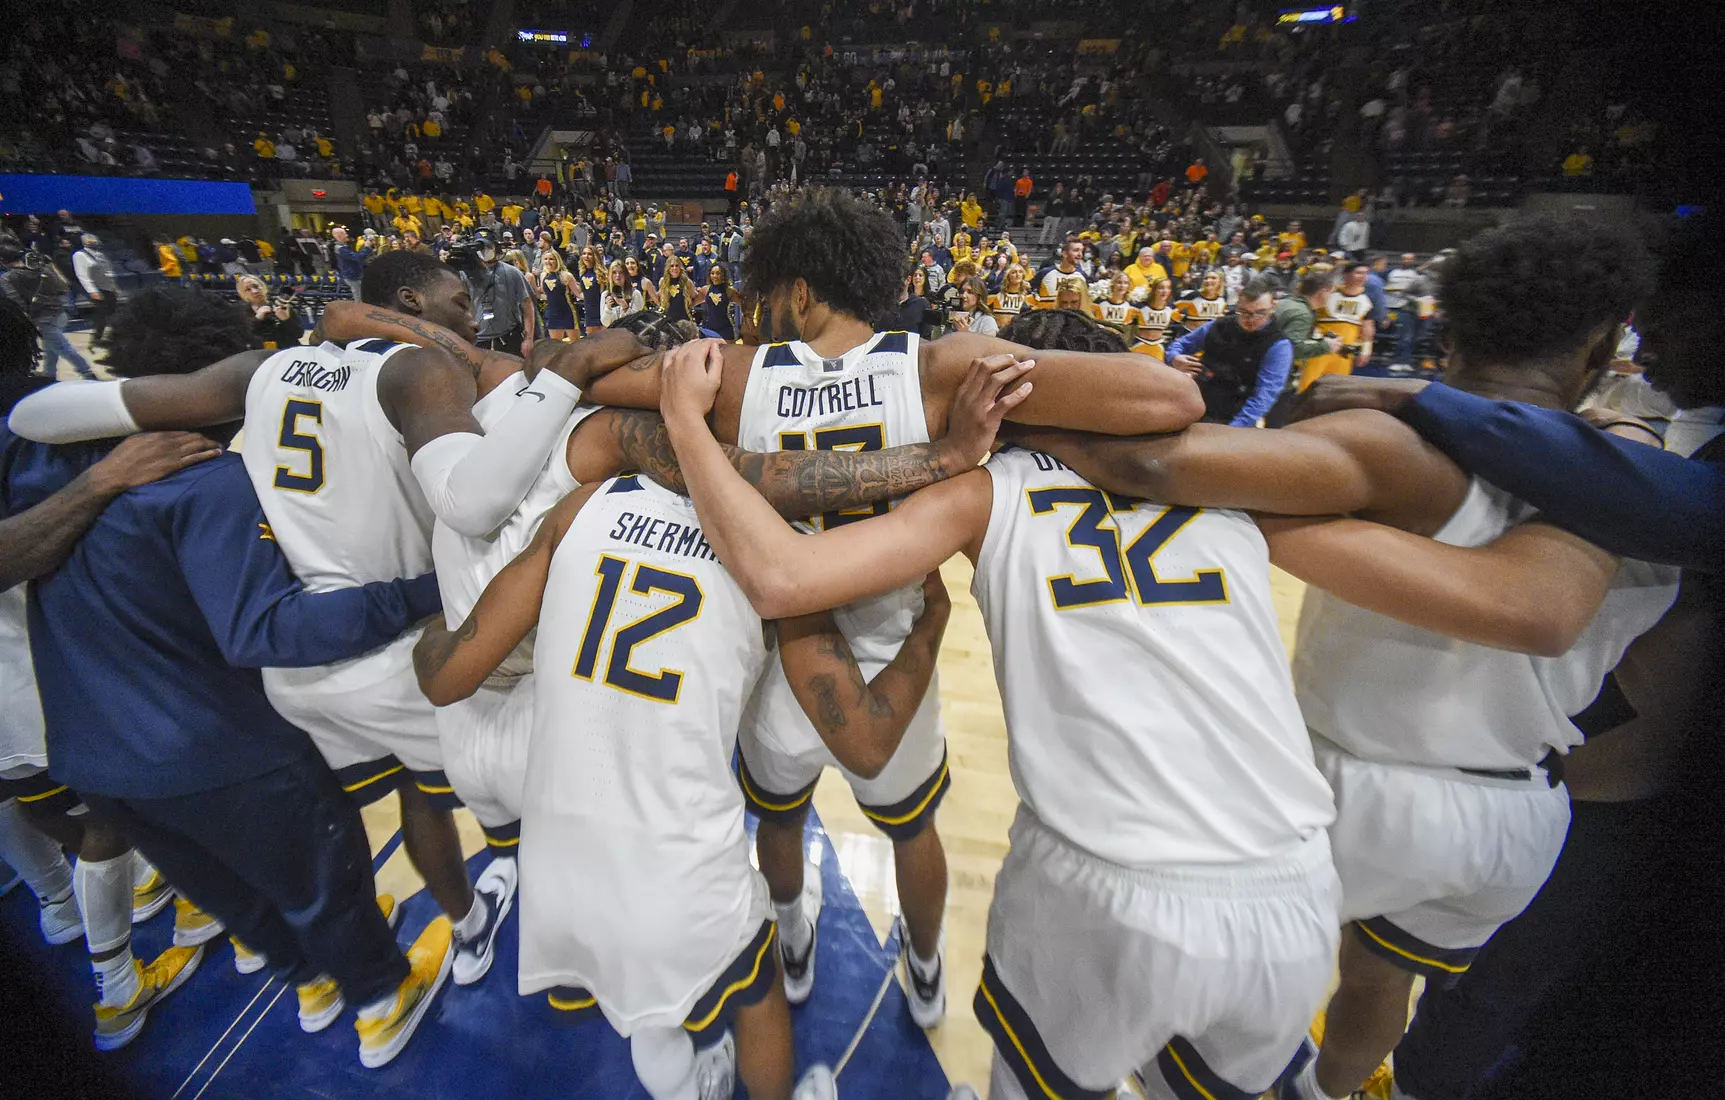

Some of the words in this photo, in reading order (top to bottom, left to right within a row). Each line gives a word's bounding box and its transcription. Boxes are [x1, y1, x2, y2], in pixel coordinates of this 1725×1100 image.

[272, 396, 327, 495] 5
[776, 374, 883, 418] COTTRELL
[1024, 484, 1231, 611] 32
[571, 553, 706, 705] 12
